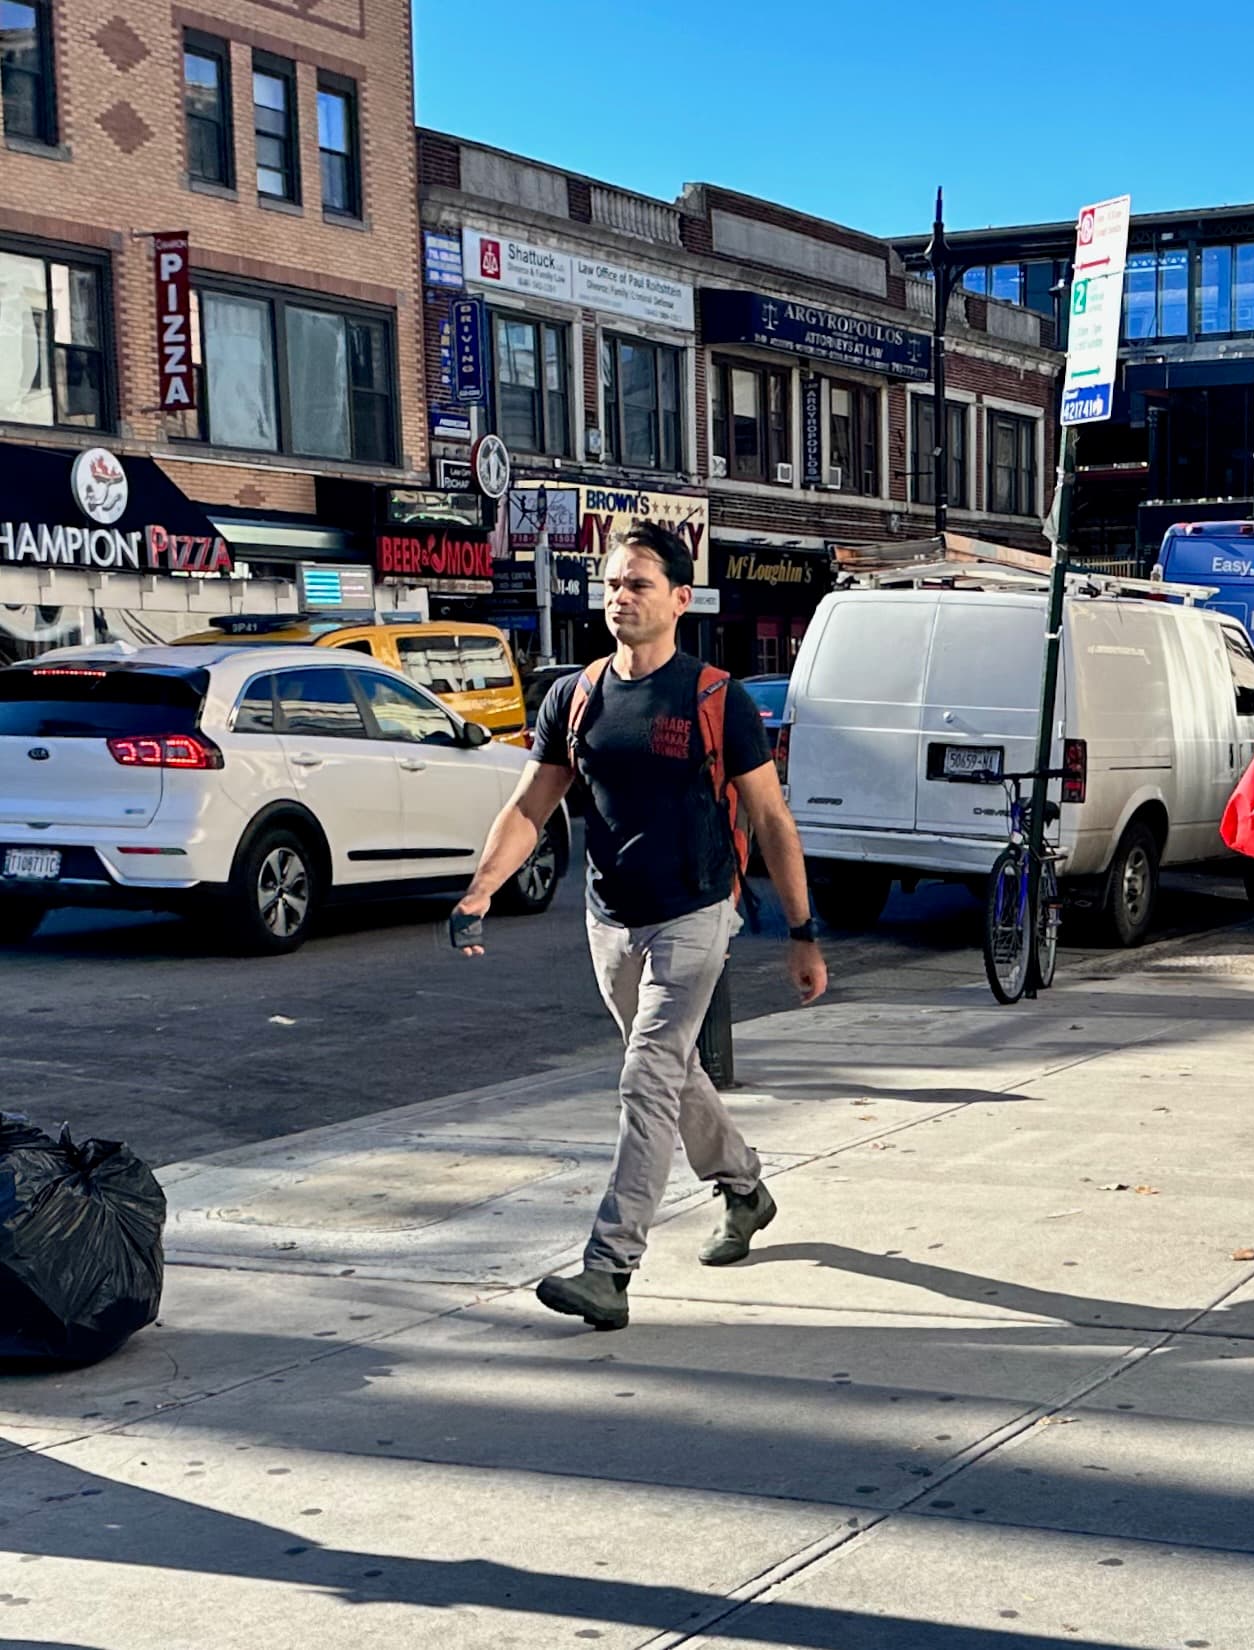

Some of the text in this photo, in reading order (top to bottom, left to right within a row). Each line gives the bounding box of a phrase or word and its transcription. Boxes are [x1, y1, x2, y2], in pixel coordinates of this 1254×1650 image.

[578, 261, 594, 275] Law
[160, 253, 190, 404] PIZZA
[459, 304, 476, 374] DRIVING
[784, 303, 904, 346] ARGYROPOULOS
[804, 331, 853, 354] ATTORNEYS
[854, 342, 864, 355] AT
[864, 346, 885, 360] LAW
[586, 489, 650, 516] BROWN'S
[145, 525, 234, 572] PIZZA
[382, 535, 422, 573] BEER
